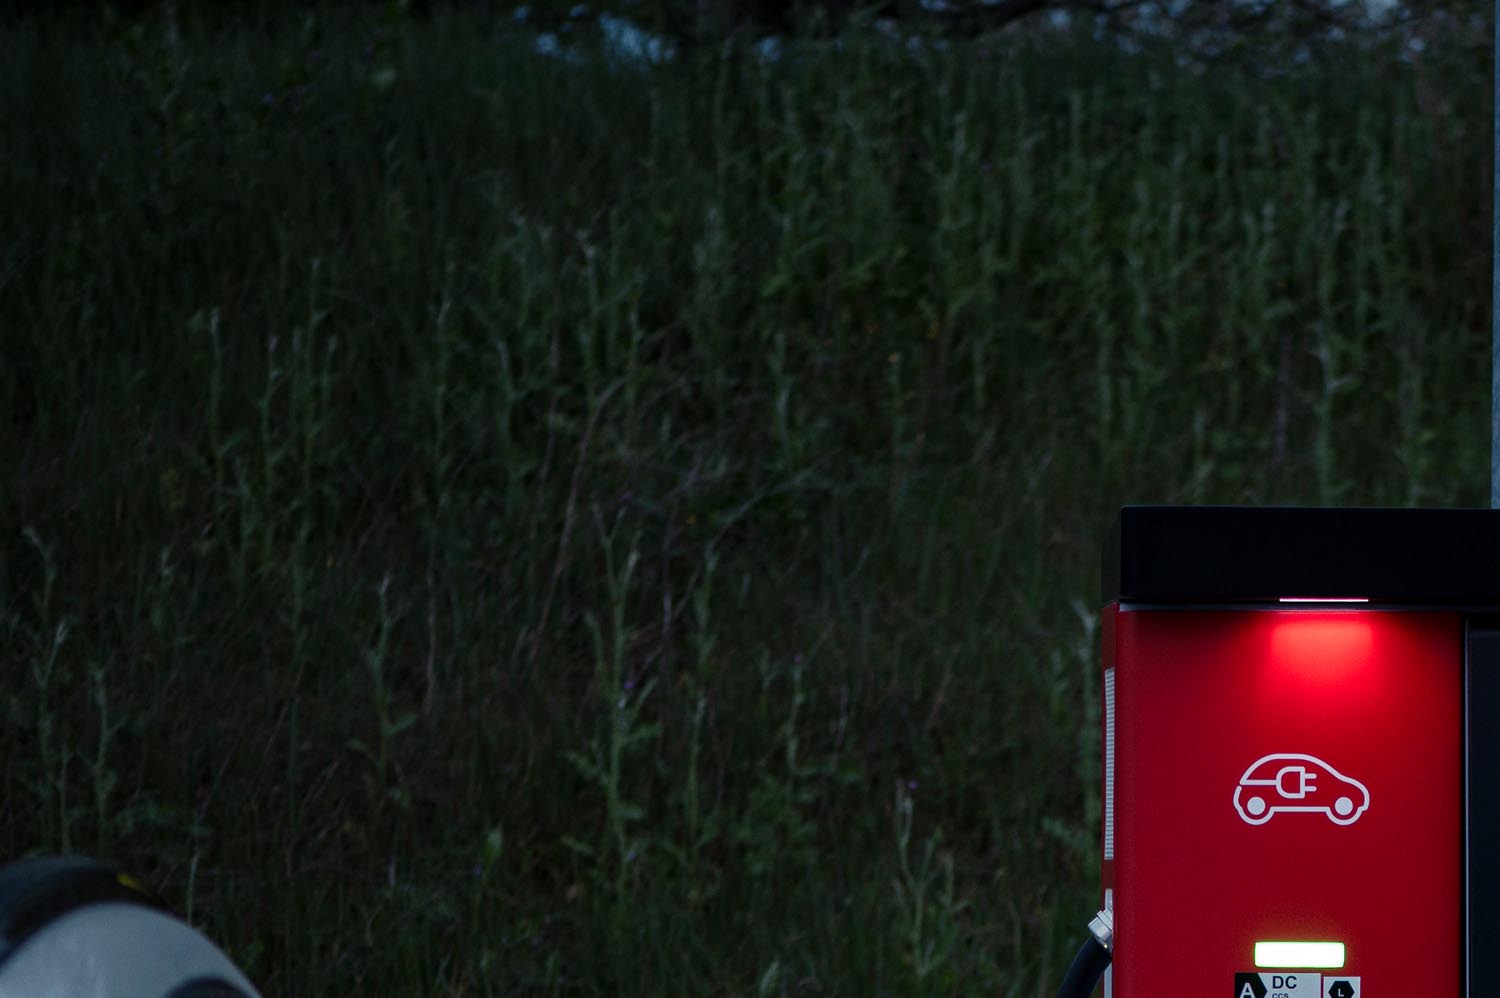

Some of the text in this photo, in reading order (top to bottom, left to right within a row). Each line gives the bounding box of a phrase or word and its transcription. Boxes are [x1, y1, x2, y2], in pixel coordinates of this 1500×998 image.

[1272, 976, 1297, 989] DC
[1240, 982, 1256, 998] A
[1337, 988, 1345, 997] L
